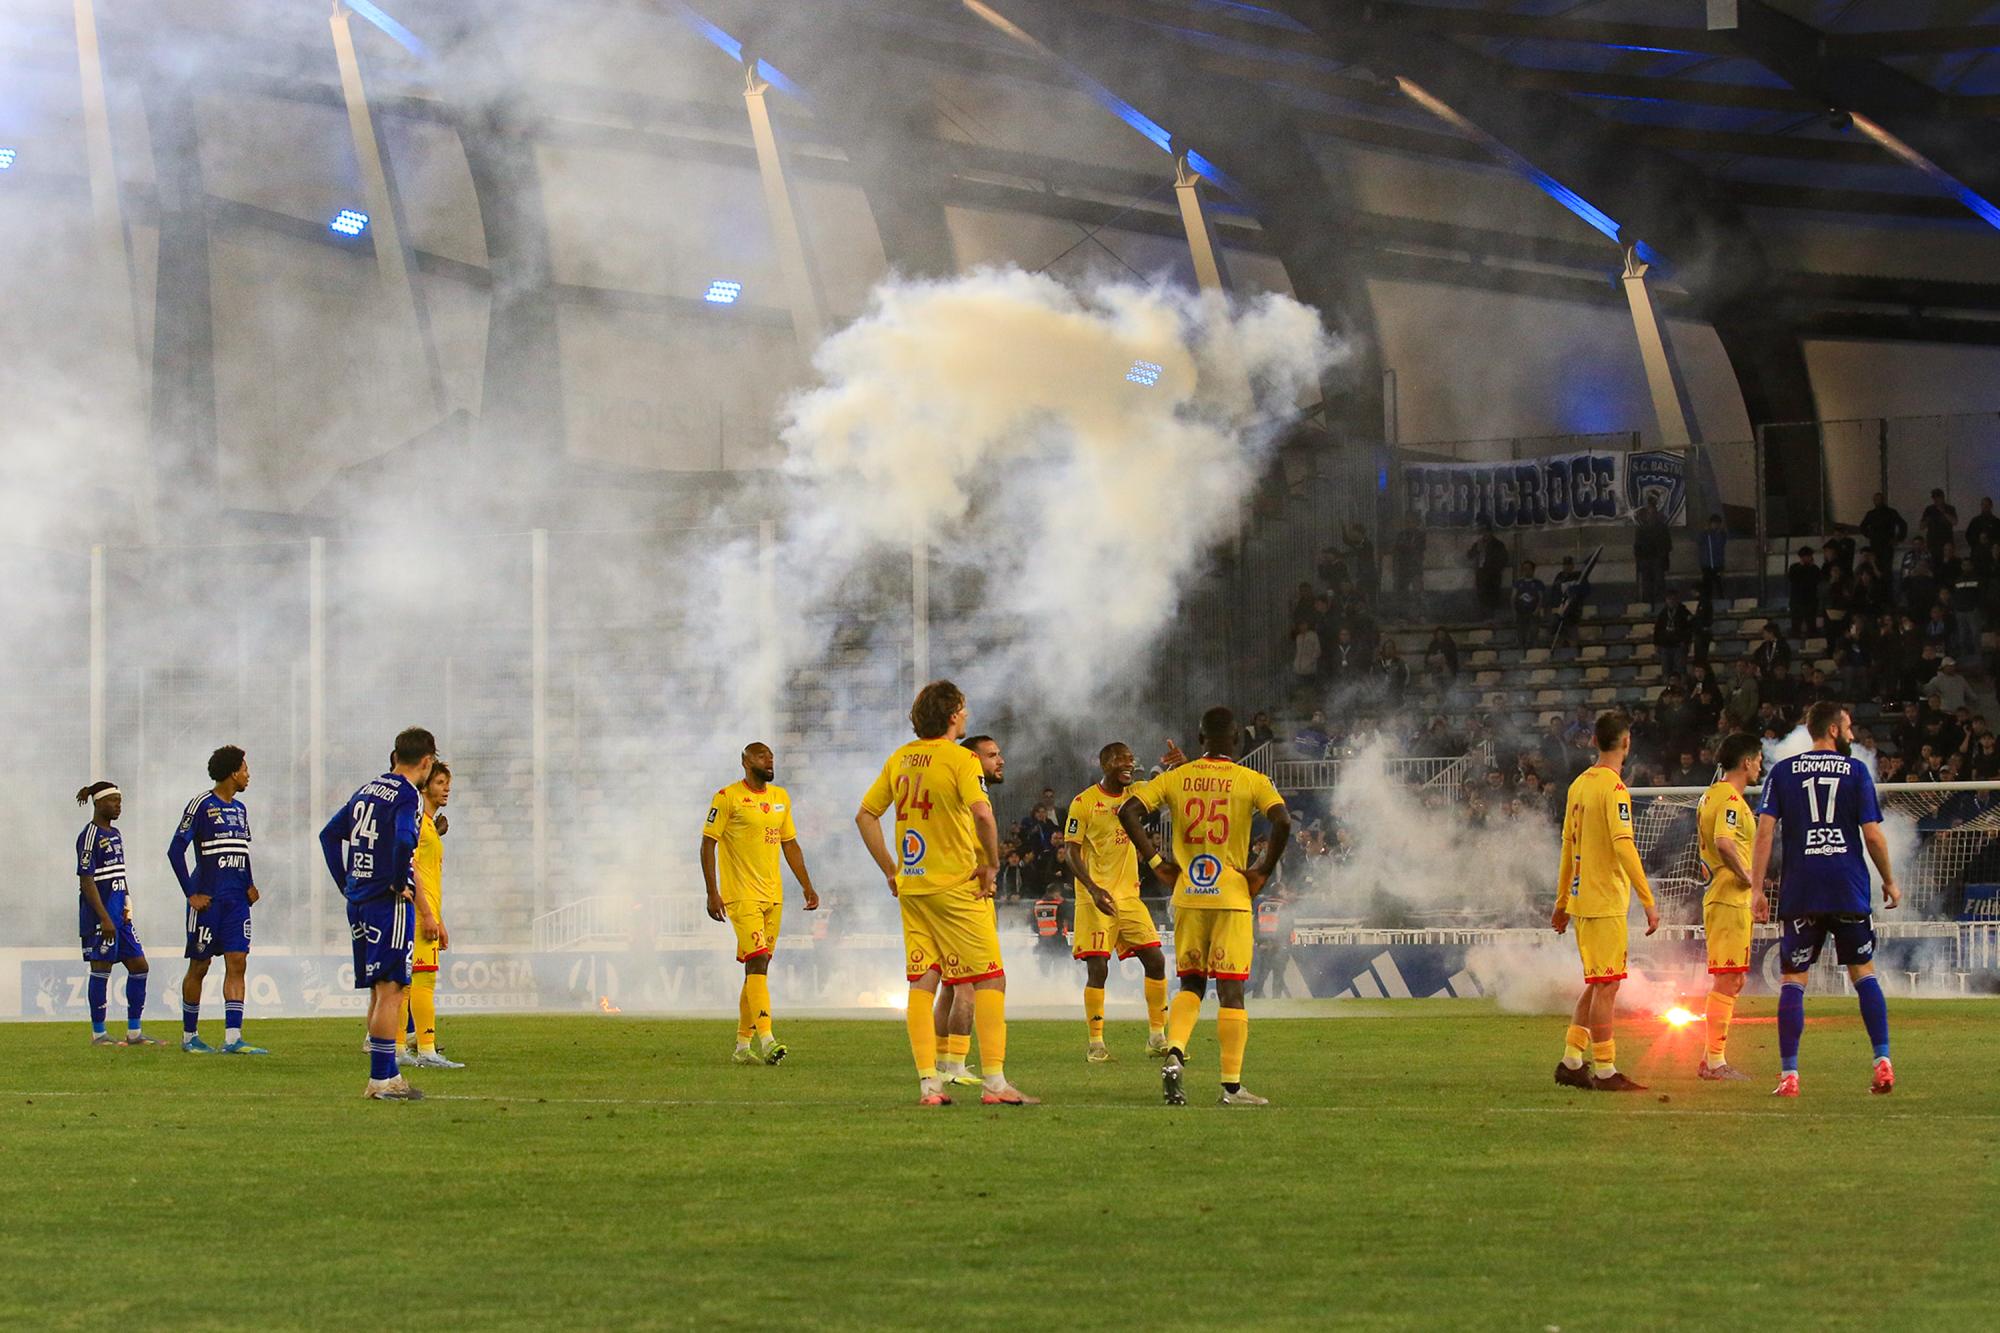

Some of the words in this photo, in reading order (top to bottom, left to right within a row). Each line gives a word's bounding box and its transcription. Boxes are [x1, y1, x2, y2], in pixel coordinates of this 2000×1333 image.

[1792, 760, 1851, 775] EICKMAYER
[896, 771, 933, 821] 24
[1802, 777, 1840, 824] 17
[351, 801, 379, 850] 24
[1183, 797, 1229, 845] 25
[198, 926, 213, 945] 14
[1091, 931, 1104, 949] 17
[451, 961, 537, 989] COSTA
